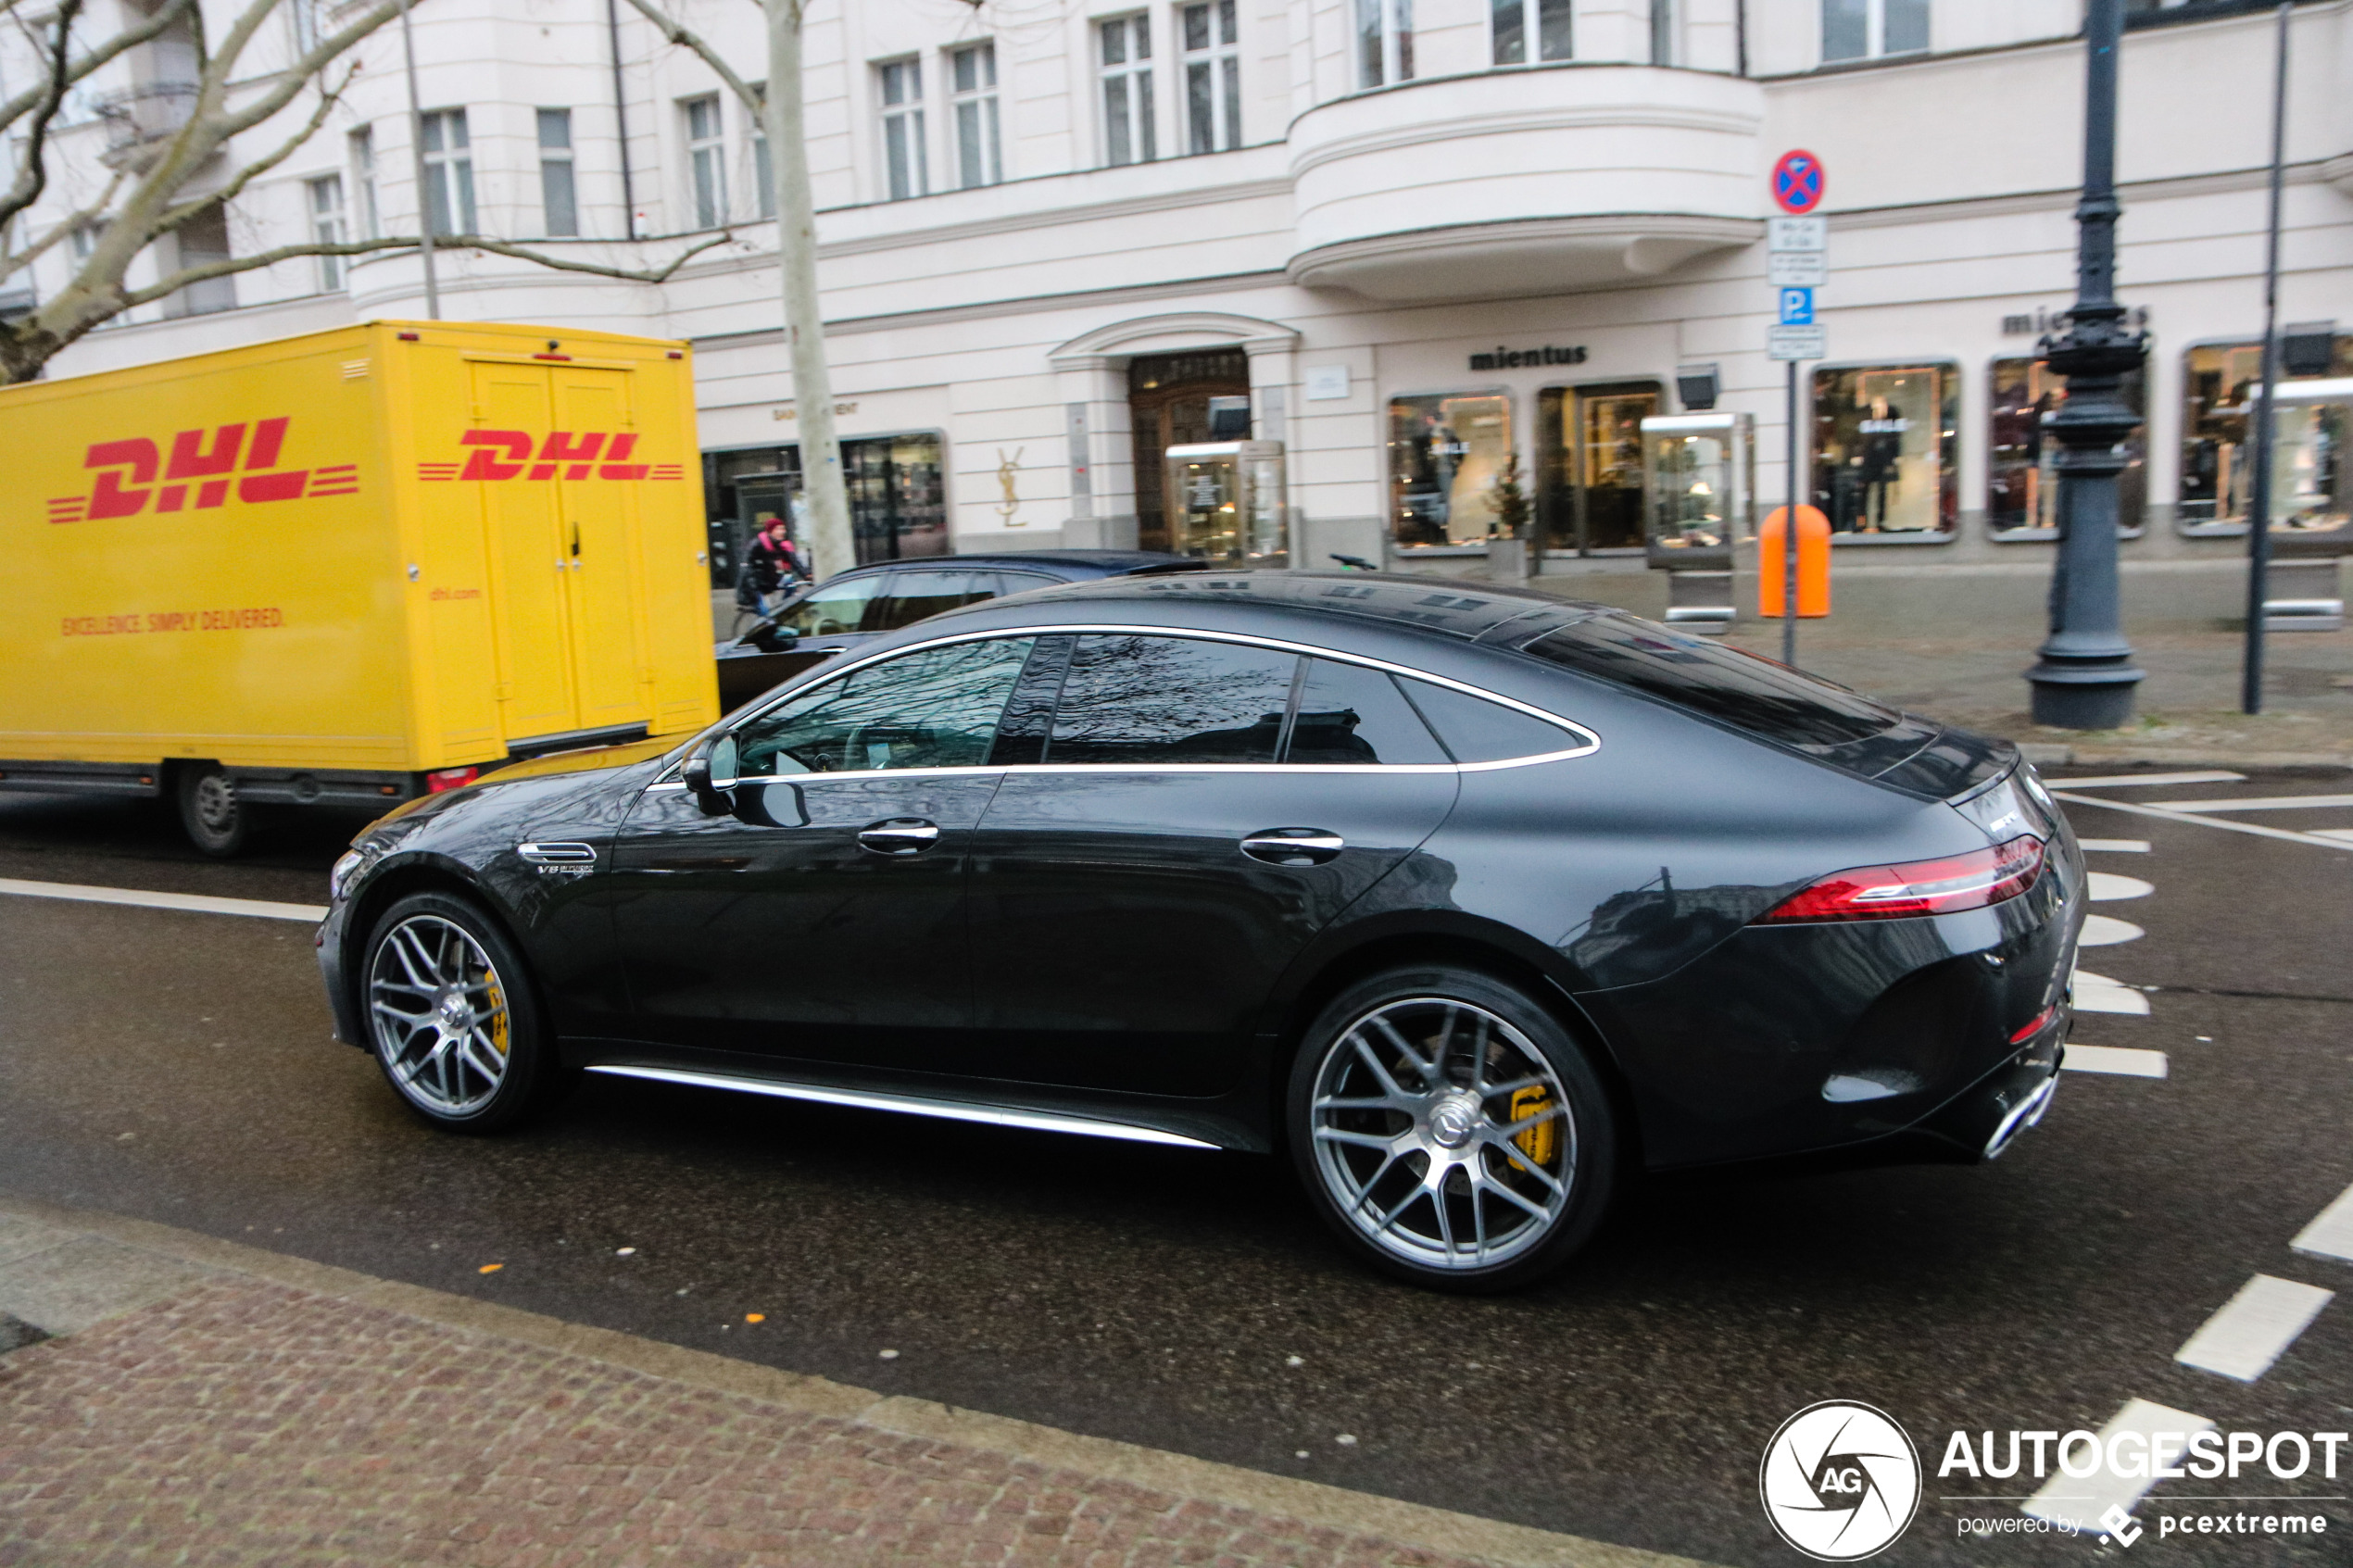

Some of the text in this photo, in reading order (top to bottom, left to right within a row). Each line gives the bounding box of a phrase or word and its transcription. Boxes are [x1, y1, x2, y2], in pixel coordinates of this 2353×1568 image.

[1468, 345, 1587, 371] mientus
[83, 416, 309, 521] DHL
[459, 429, 649, 482] DHL
[146, 611, 197, 633] SIMPLY
